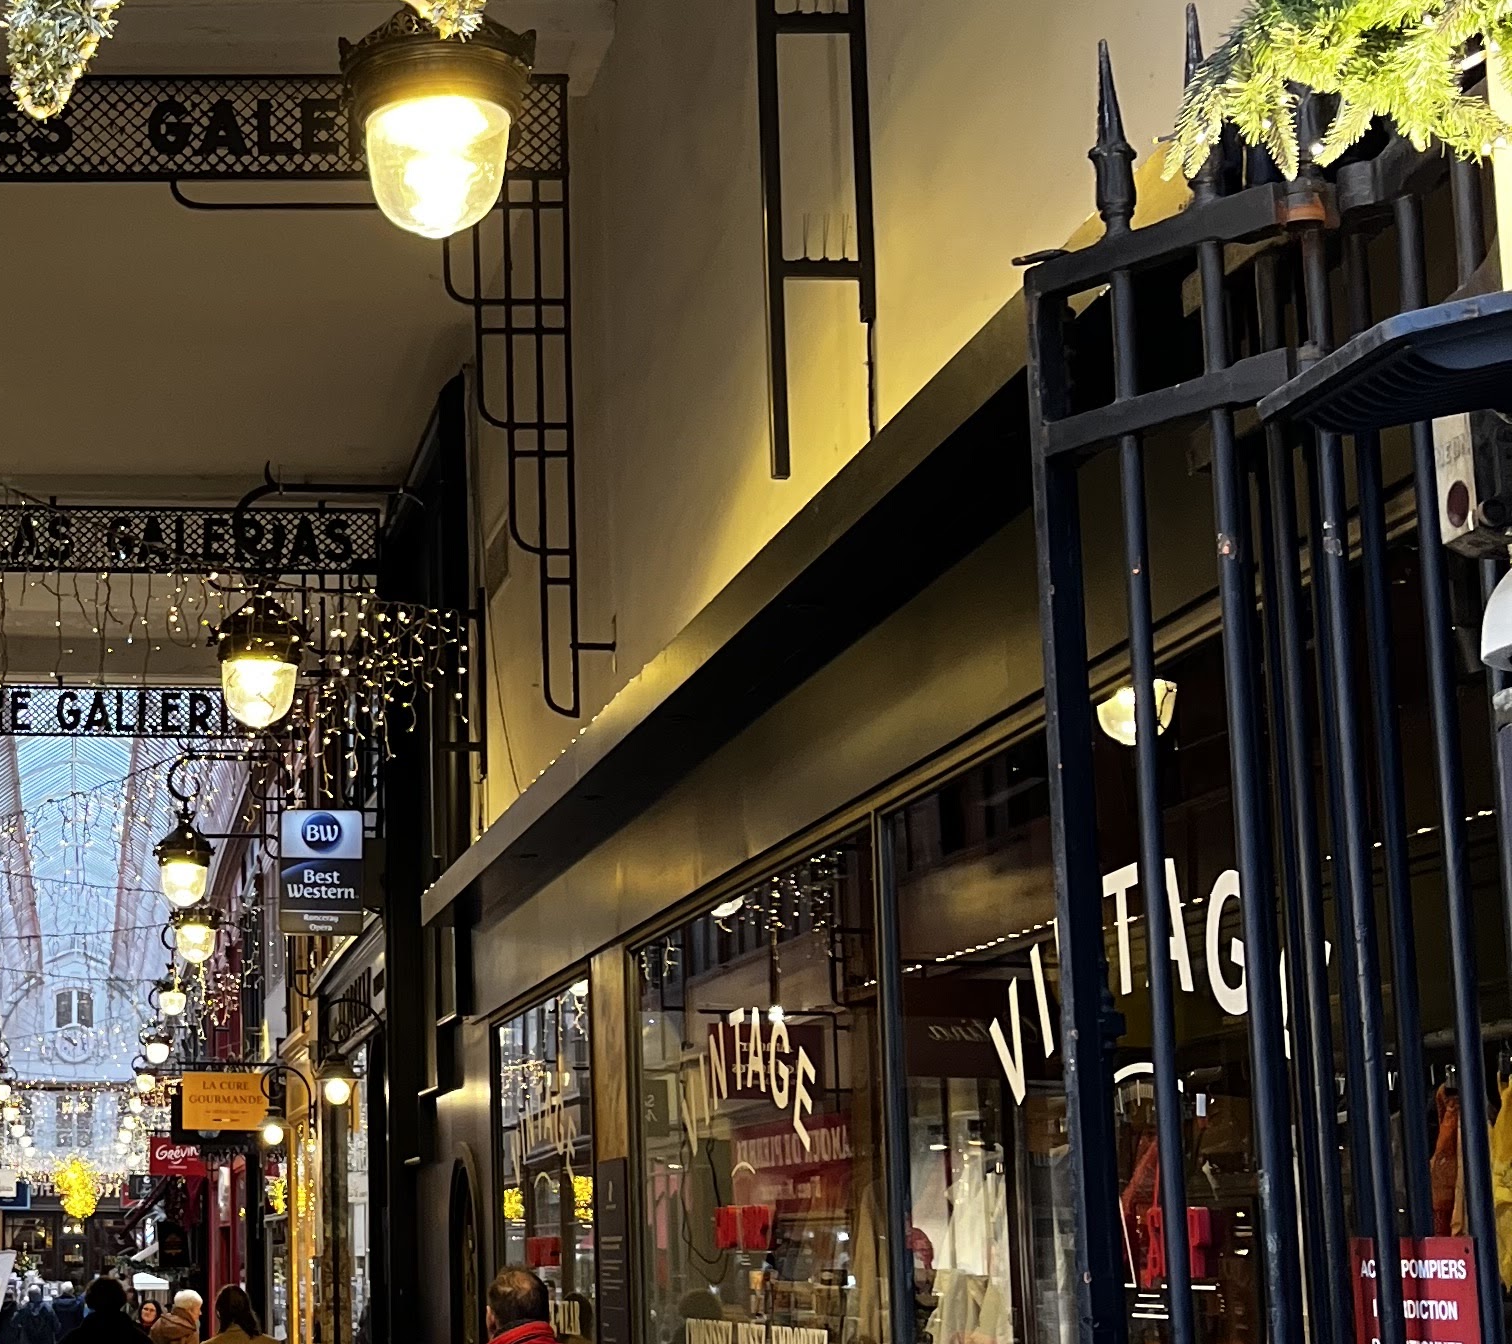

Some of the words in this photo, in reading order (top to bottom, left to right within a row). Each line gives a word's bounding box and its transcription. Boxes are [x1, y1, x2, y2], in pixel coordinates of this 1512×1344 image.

[306, 824, 338, 842] BW
[303, 869, 340, 885] Best
[287, 883, 355, 899] Western
[202, 1080, 216, 1090] LA
[219, 1080, 250, 1091] CURE
[681, 1006, 816, 1156] VINTAGE
[188, 1095, 265, 1105] GOURMANDE
[1401, 1259, 1467, 1280] POMPIERS
